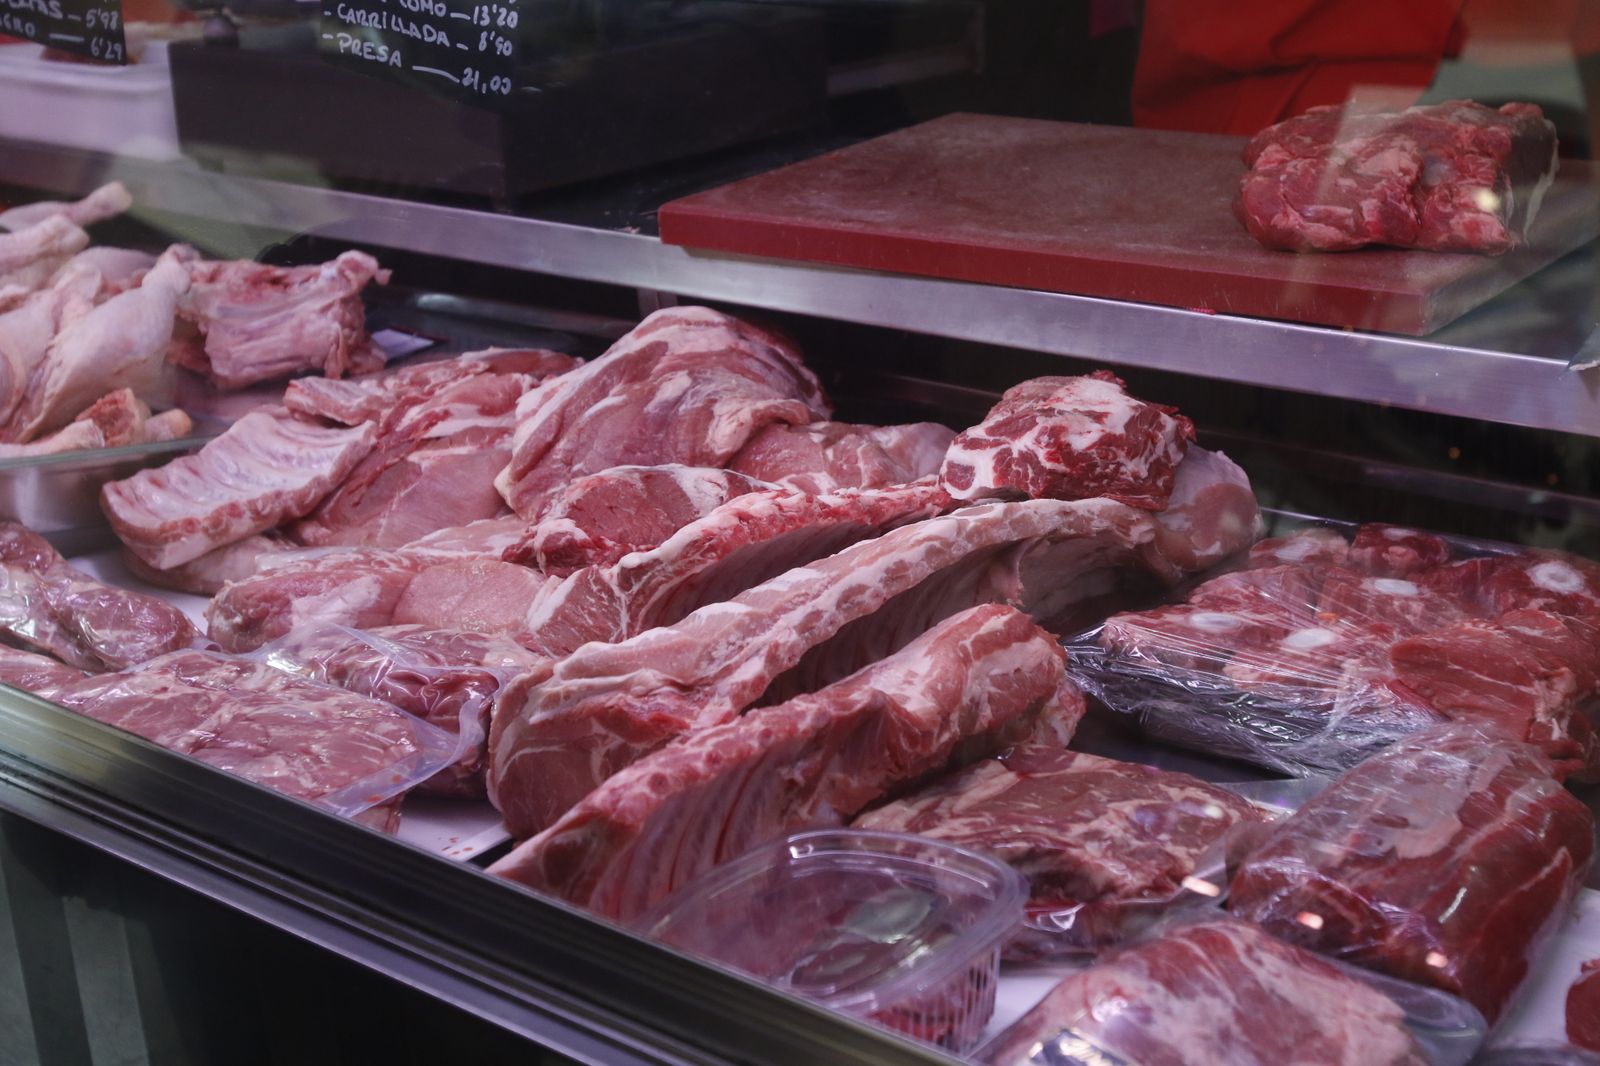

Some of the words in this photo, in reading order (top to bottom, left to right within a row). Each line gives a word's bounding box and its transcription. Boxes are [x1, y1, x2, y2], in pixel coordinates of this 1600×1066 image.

[337, 3, 450, 47] CARRILLADA
[473, 4, 518, 28] 13'20
[336, 32, 402, 68] PRESA
